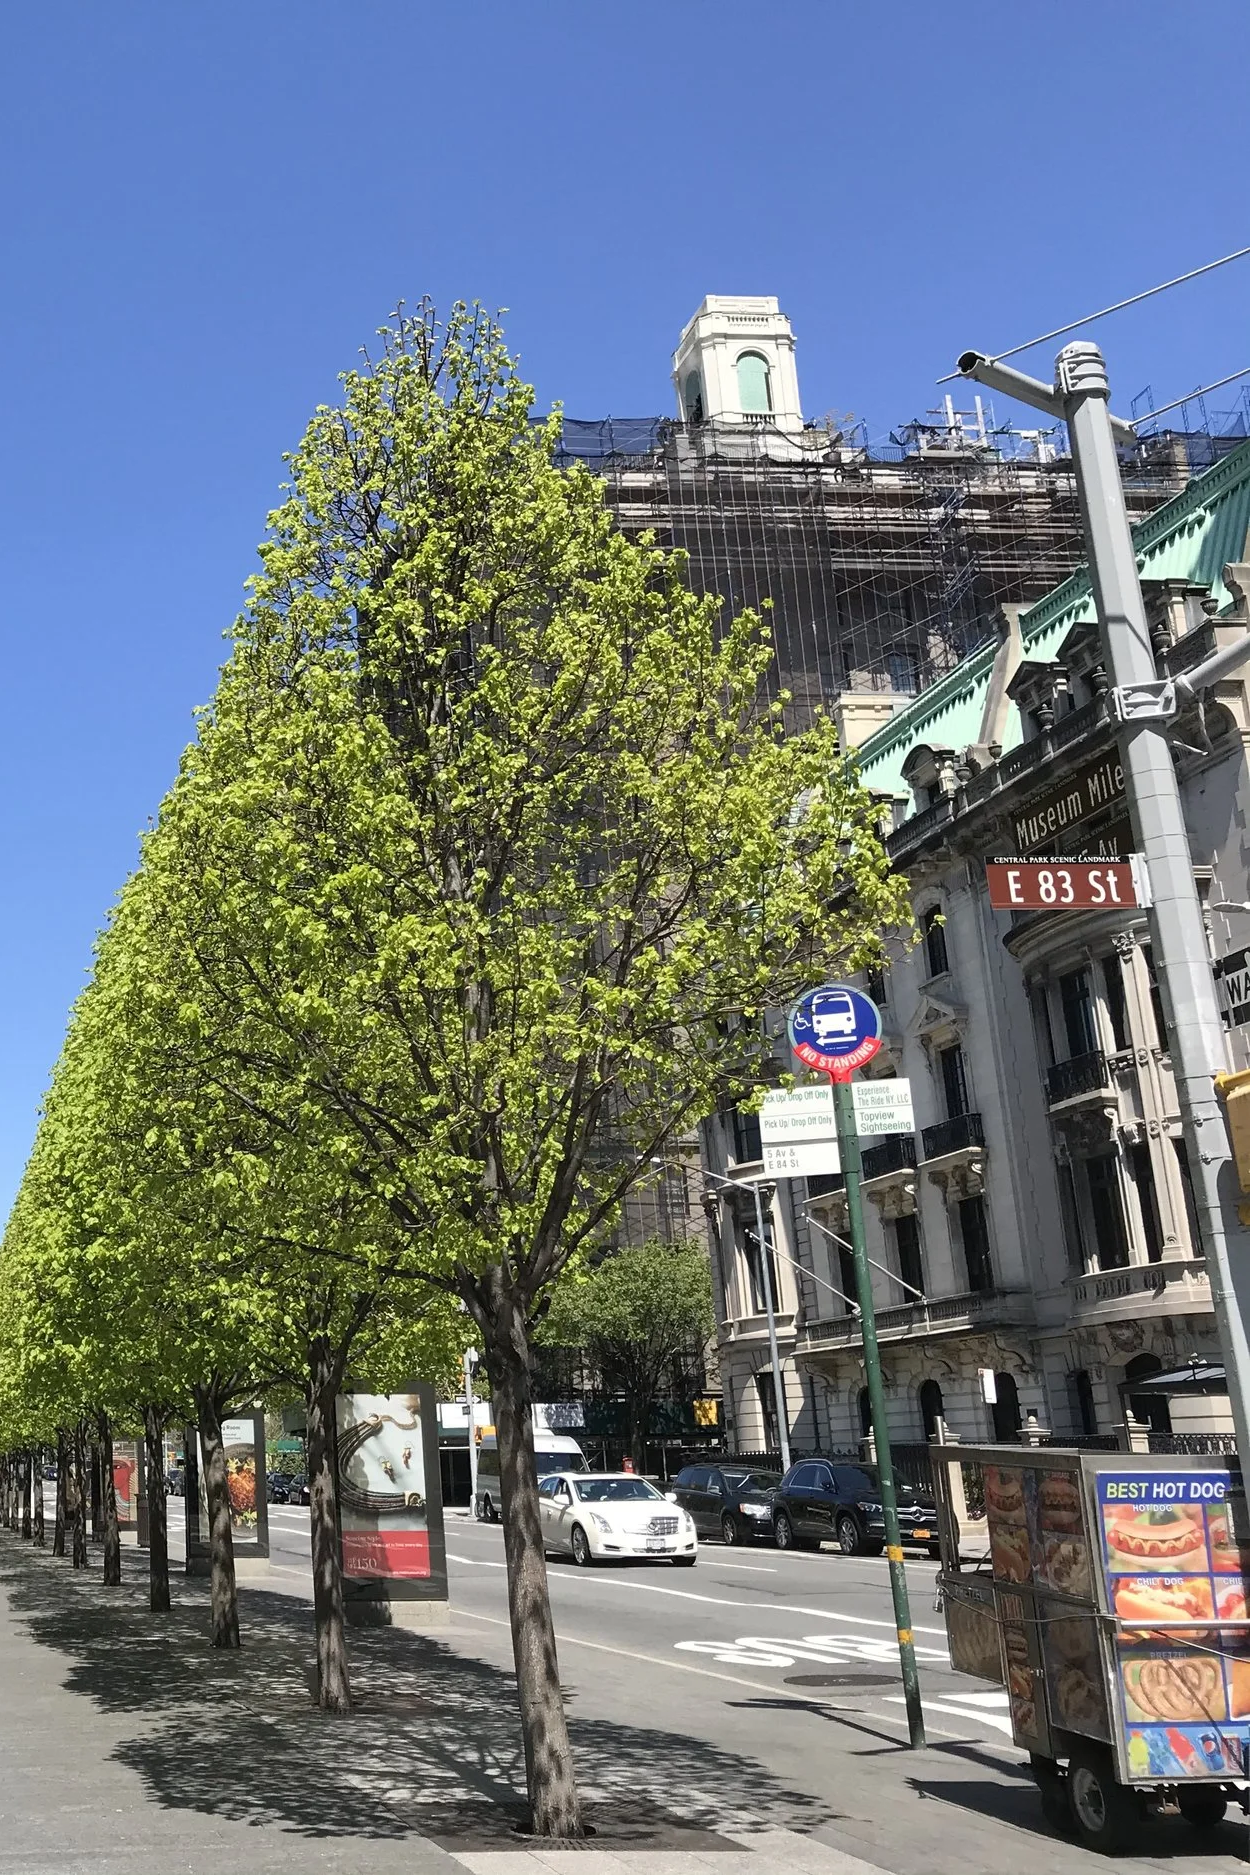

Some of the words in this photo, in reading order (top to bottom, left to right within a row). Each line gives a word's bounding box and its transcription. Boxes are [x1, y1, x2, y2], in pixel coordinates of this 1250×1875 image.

[1016, 791, 1082, 849] Museum
[1087, 763, 1125, 807] Mile
[1078, 855, 1121, 863] LANDMARK
[1007, 870, 1025, 903] E
[1038, 870, 1074, 903] 83
[1088, 869, 1121, 903] St
[800, 1047, 817, 1062] NO
[818, 1041, 874, 1069] STANDING
[764, 1095, 774, 1103] ick
[788, 1093, 803, 1102] Drop
[804, 1090, 813, 1100] Off
[815, 1089, 829, 1100] Only
[857, 1086, 890, 1096] Experience
[858, 1097, 869, 1106] The
[870, 1096, 884, 1105] Ride
[896, 1093, 909, 1103] LLC
[764, 1120, 778, 1128] Pick
[791, 1118, 807, 1127] Drop
[807, 1116, 817, 1125] Off
[818, 1115, 832, 1125] Only
[859, 1111, 895, 1123] Topview
[860, 1121, 911, 1133] Sightseeing
[767, 1150, 773, 1159] 5
[775, 1149, 787, 1158] Av
[789, 1149, 795, 1157] &
[768, 1161, 774, 1169] E
[776, 1159, 787, 1168] 84
[790, 1158, 799, 1168] St
[1106, 1483, 1149, 1498] BEST
[1152, 1482, 1186, 1498] HOT
[1190, 1482, 1226, 1498] DOG
[1132, 1504, 1150, 1512] HOT
[1152, 1504, 1173, 1512] DOG
[1136, 1577, 1160, 1586] CHILI
[1164, 1577, 1184, 1586] DOG
[1150, 1651, 1187, 1659] PRETZEL
